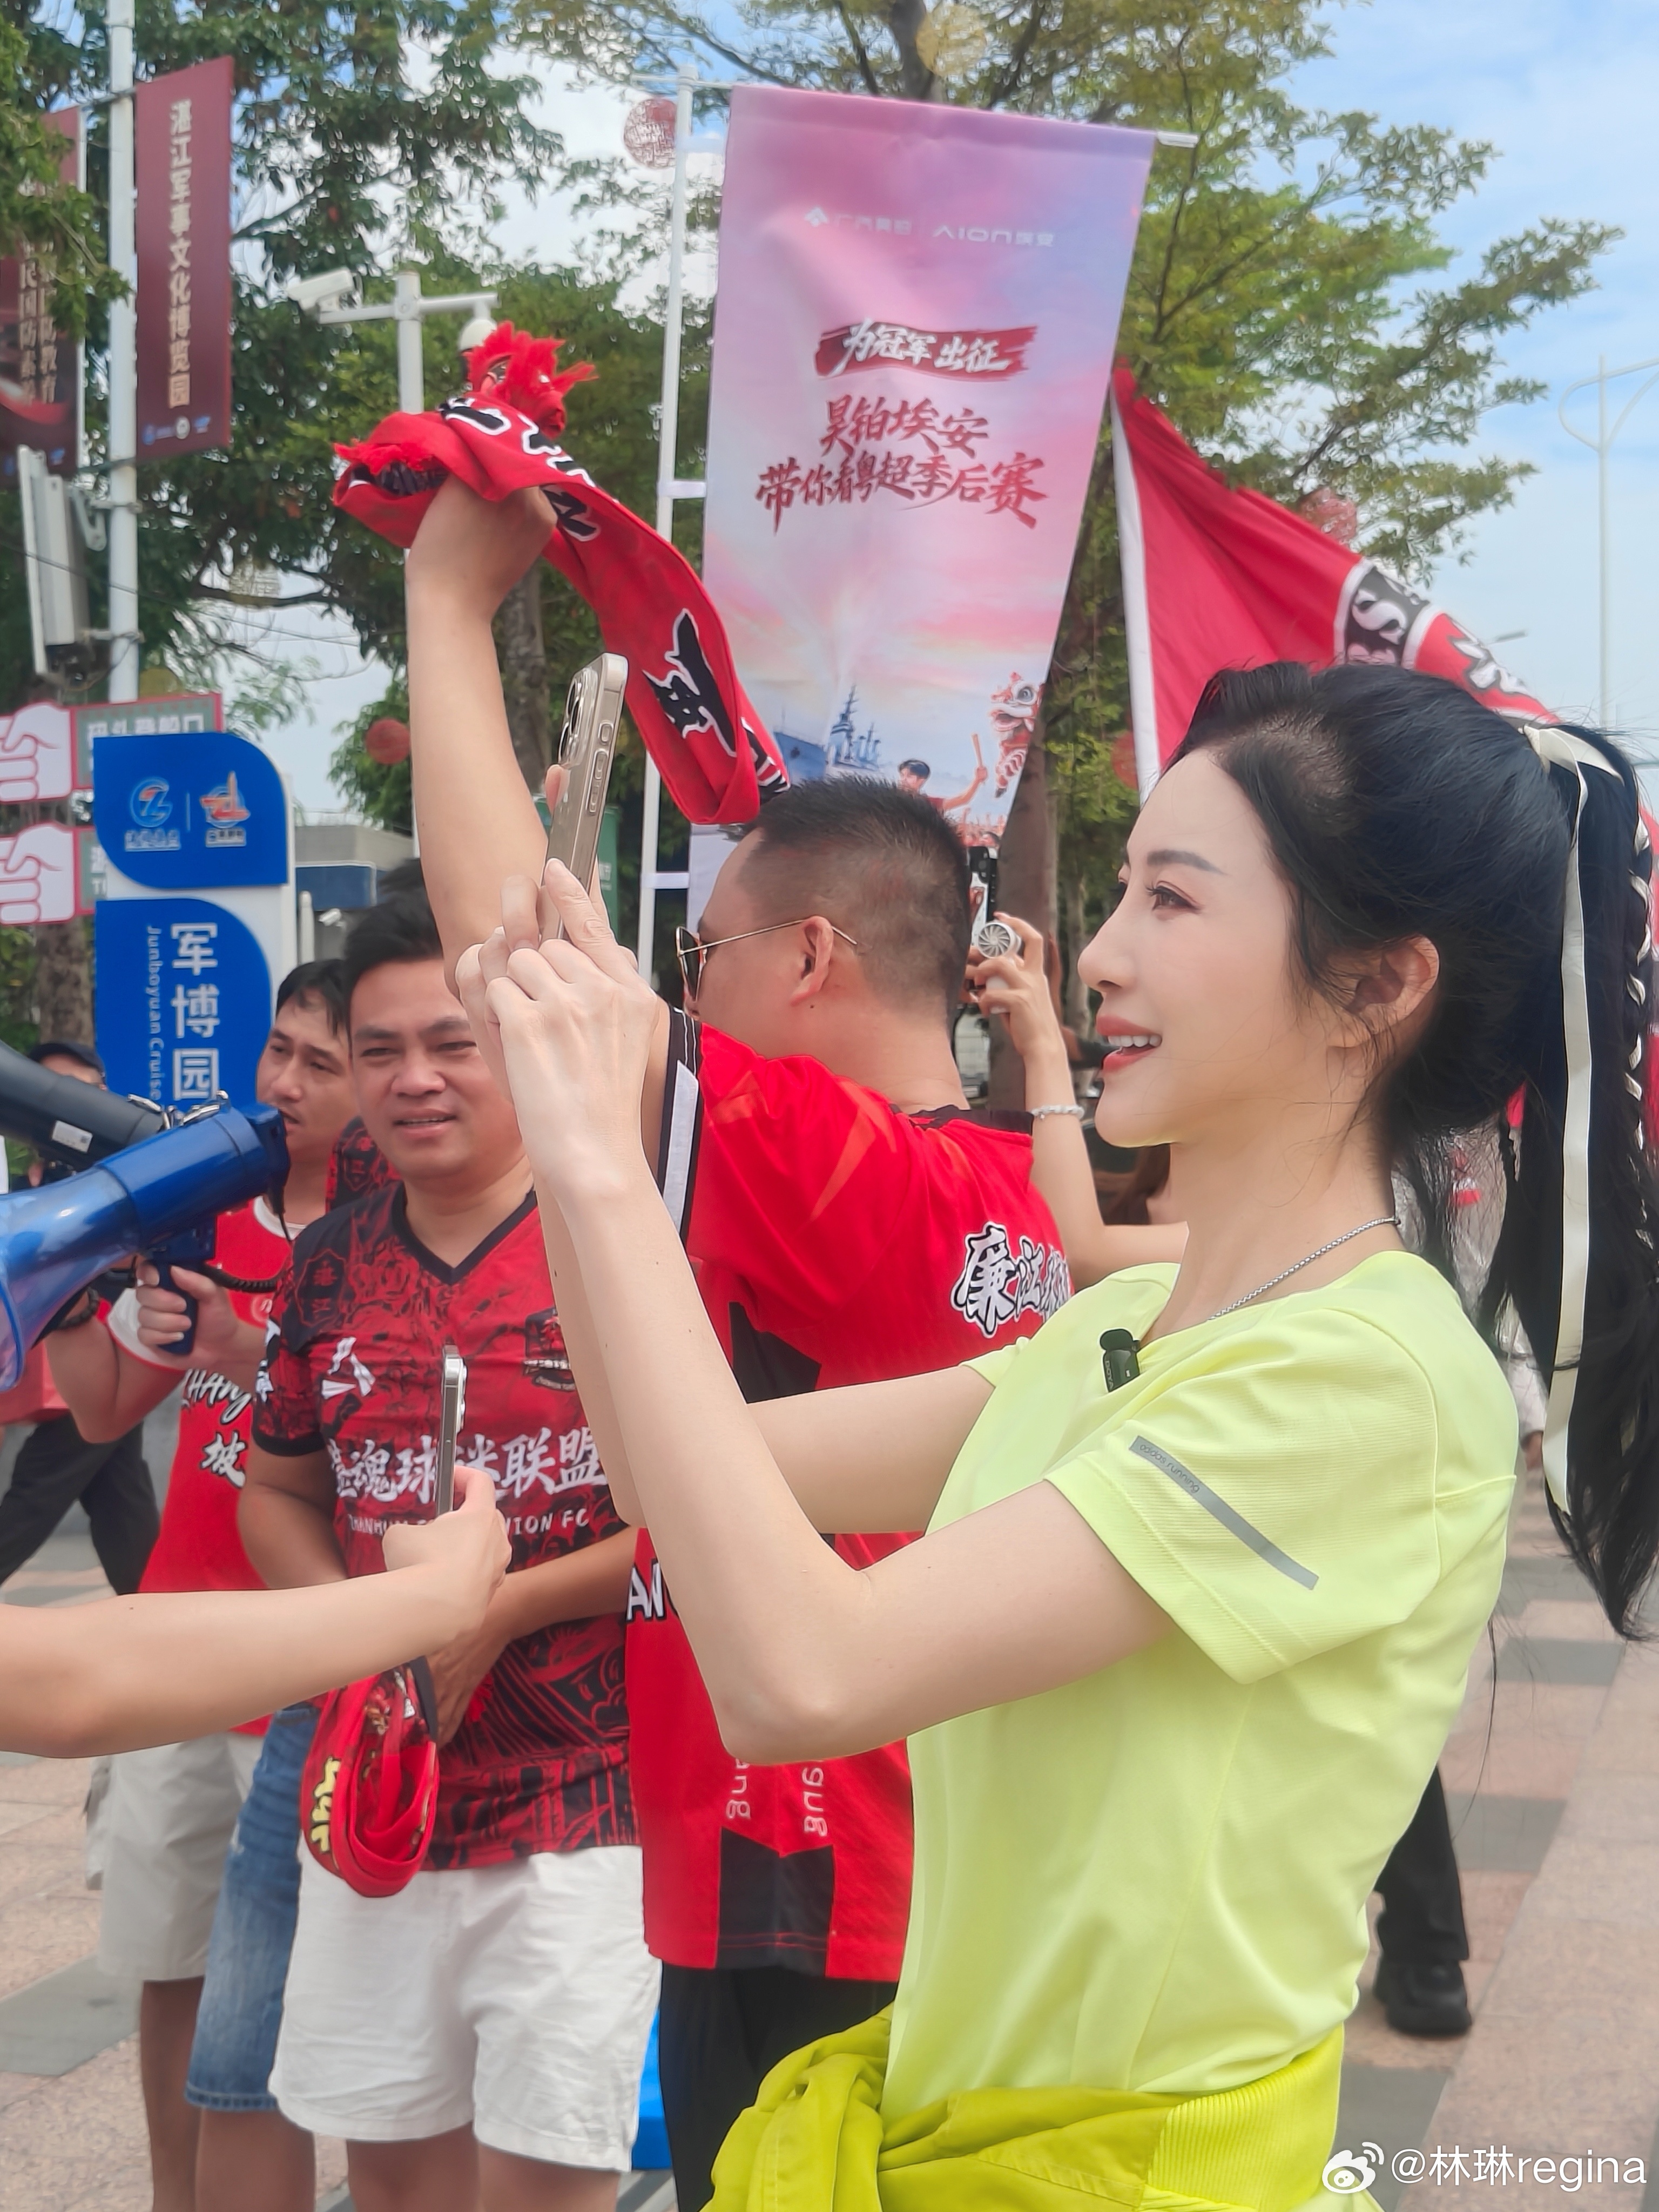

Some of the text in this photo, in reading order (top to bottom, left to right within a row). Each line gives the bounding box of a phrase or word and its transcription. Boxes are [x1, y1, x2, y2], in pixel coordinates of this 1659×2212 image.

[168, 99, 193, 409] 湛江军事文化博览园
[827, 317, 1013, 377] 为冠军出征
[819, 393, 989, 459] 昊铂埃安
[755, 451, 1049, 535] 带你看粤超季后赛
[170, 922, 220, 1102] 军博园
[1166, 1461, 1201, 1493] running
[562, 1508, 590, 1528] FC
